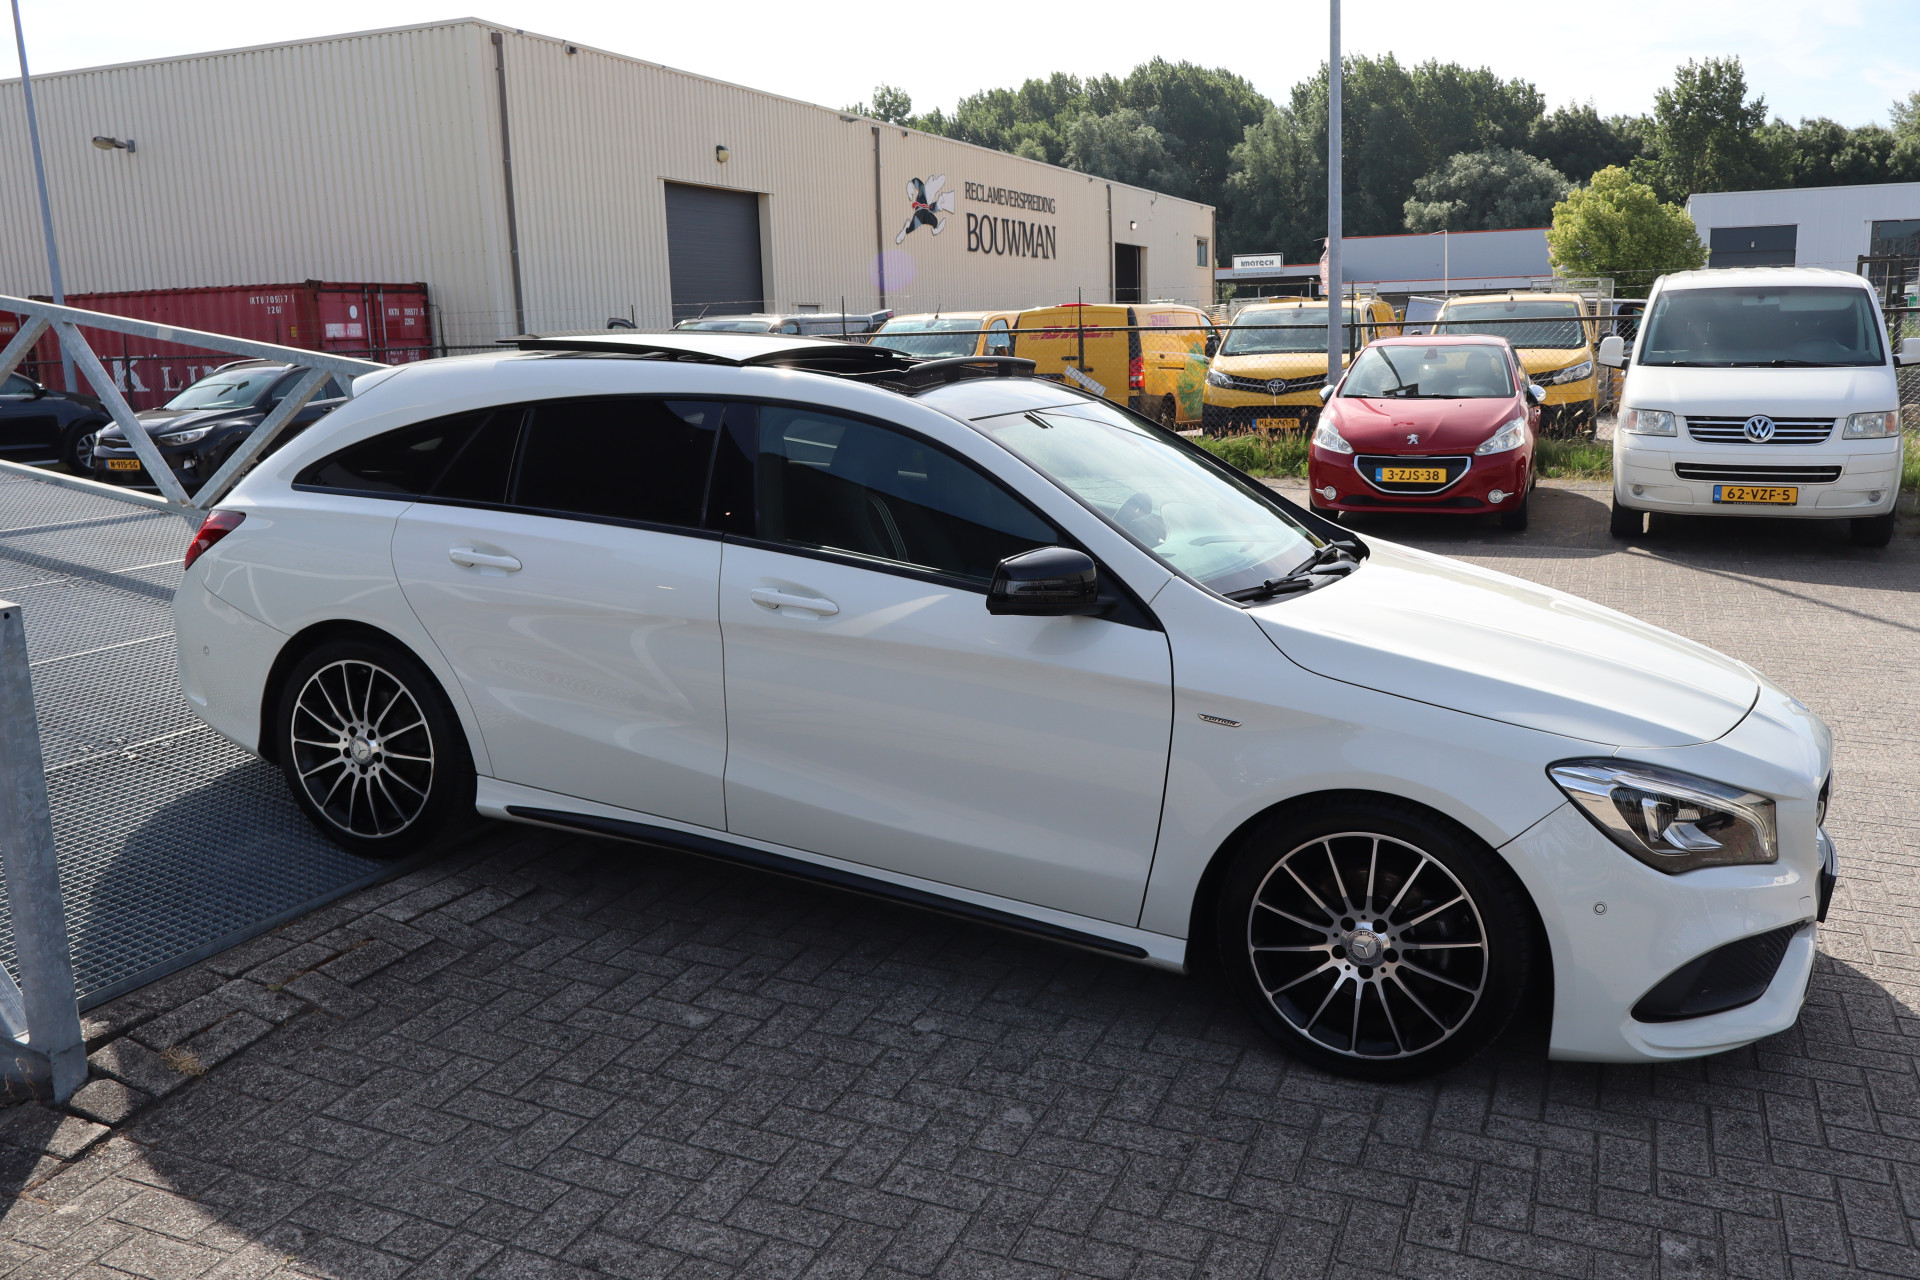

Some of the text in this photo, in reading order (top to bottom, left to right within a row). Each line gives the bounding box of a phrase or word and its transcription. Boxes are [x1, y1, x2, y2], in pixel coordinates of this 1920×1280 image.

[965, 181, 1056, 215] RECLAMEVERSPREIDING
[966, 212, 1057, 260] BOUWMAN
[1387, 469, 1440, 481] 3-ZJS-38
[1727, 488, 1790, 501] 62-VZF-5
